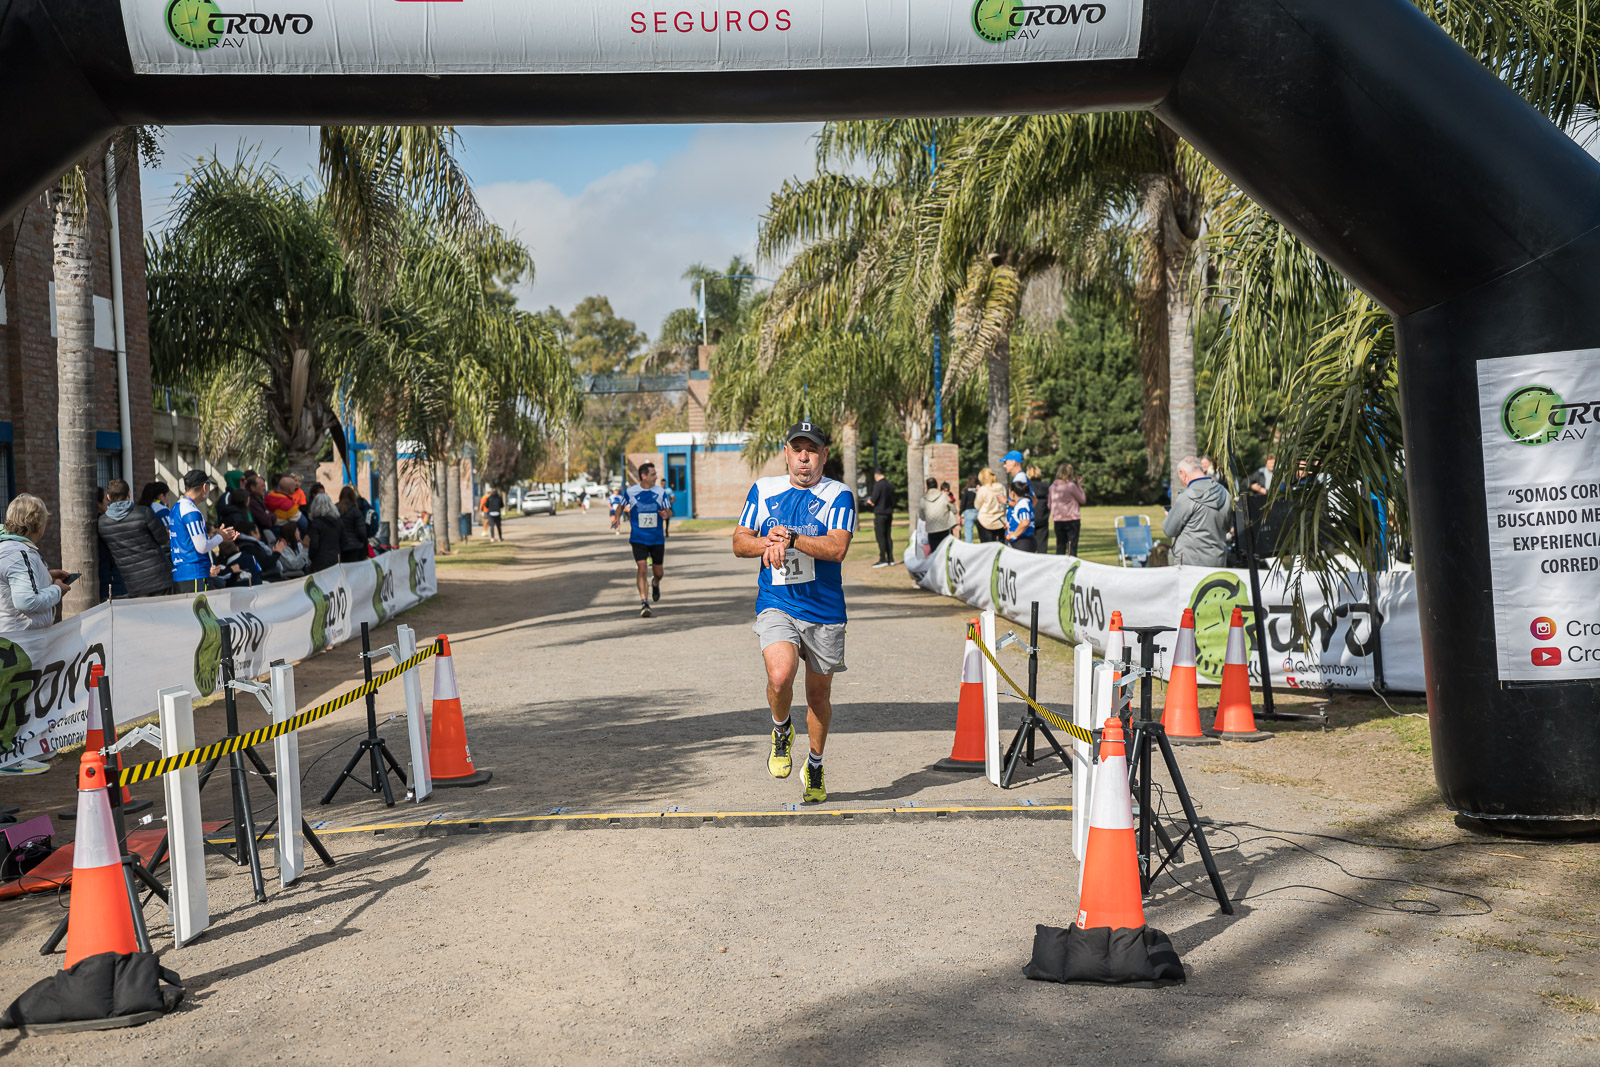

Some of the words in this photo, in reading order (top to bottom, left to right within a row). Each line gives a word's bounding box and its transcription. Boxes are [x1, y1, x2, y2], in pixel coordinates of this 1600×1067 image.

[207, 13, 313, 34] CRONO
[630, 9, 792, 34] SEGUROS
[1009, 4, 1107, 26] CRONO
[207, 38, 245, 48] RAV
[1006, 29, 1040, 41] RAV
[800, 422, 812, 432] D
[1547, 428, 1587, 442] RAV
[1571, 483, 1600, 500] COR
[643, 517, 653, 526] 72
[1497, 509, 1578, 529] BUSCANDO
[1512, 532, 1600, 552] EXPERIENCI
[1541, 556, 1600, 574] CORRED
